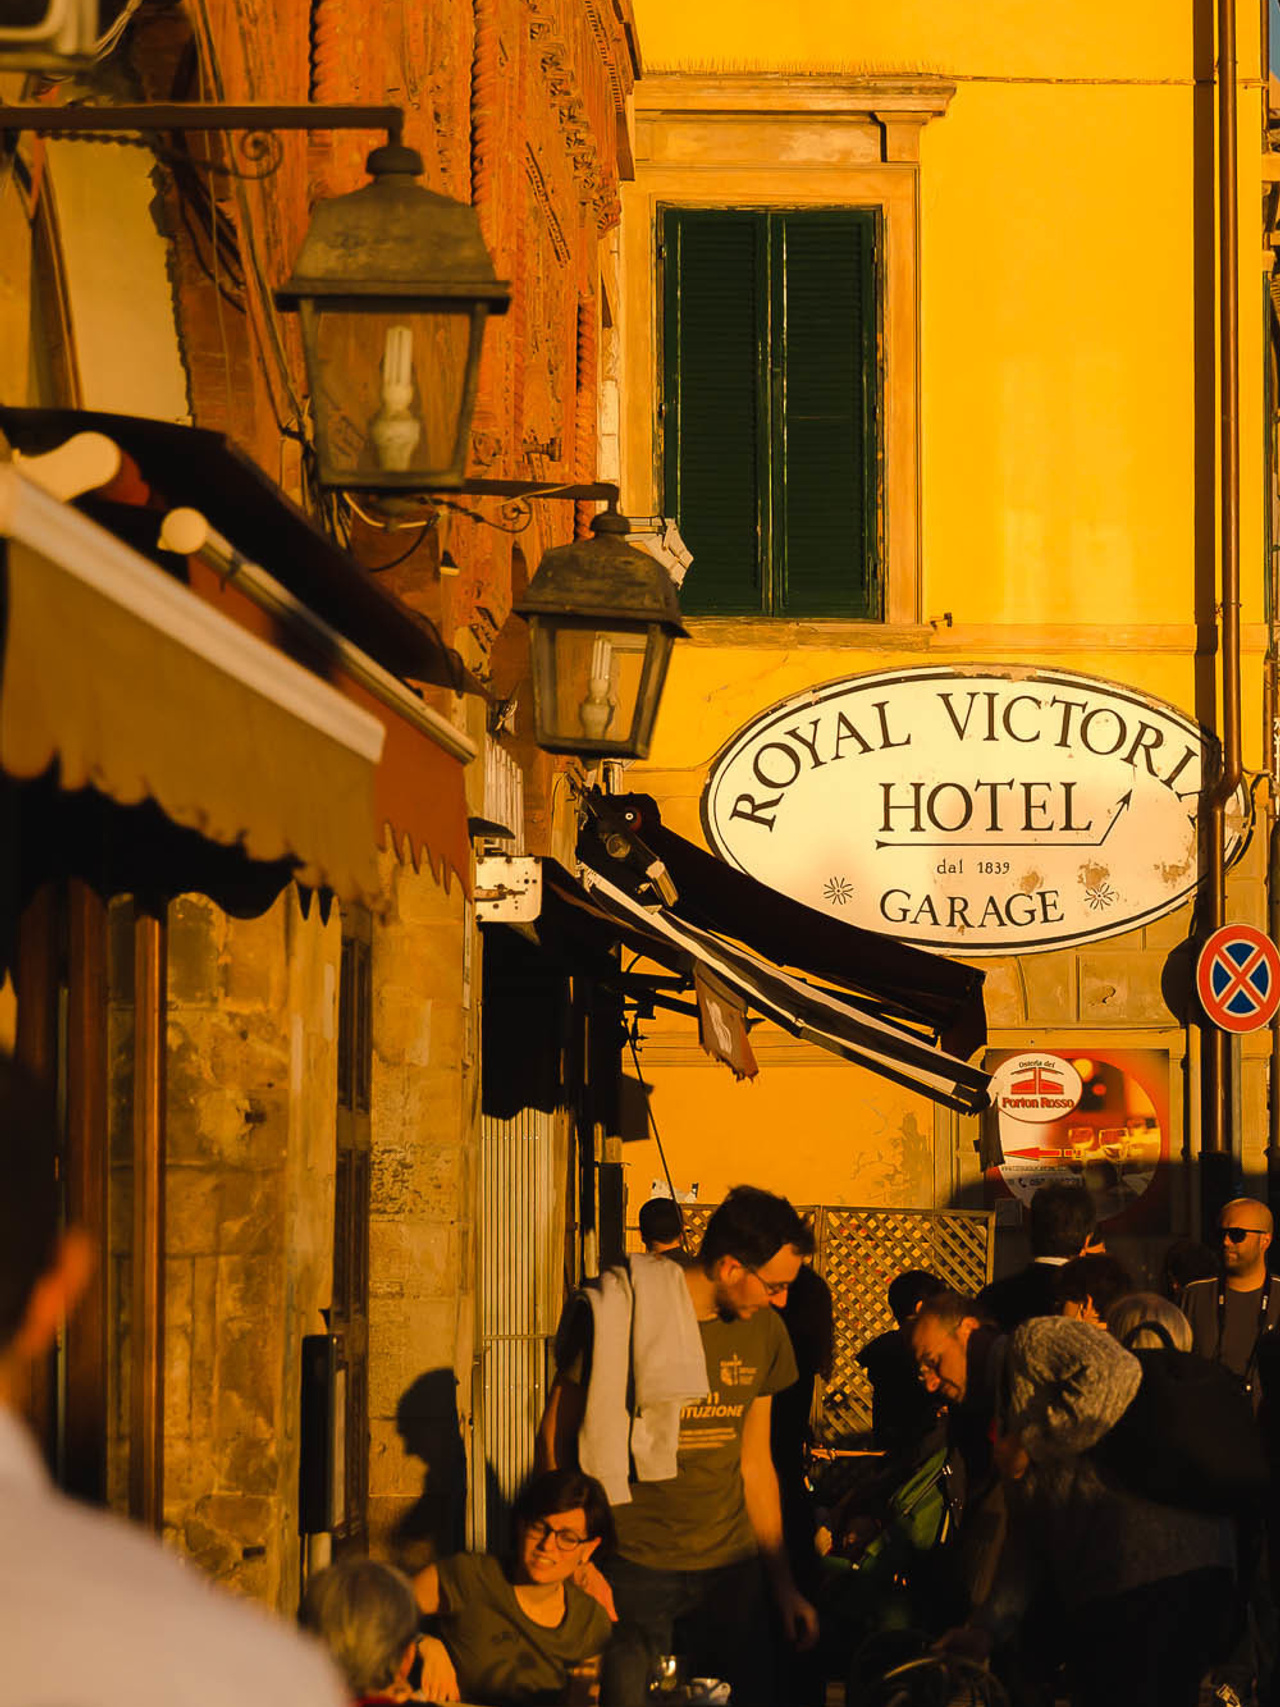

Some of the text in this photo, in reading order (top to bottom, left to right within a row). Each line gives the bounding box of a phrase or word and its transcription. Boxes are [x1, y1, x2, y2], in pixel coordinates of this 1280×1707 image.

[729, 691, 1205, 832] ROYAL VICTORI
[877, 777, 1093, 833] HOTEL
[936, 858, 1010, 875] dal 1839
[879, 888, 1065, 929] GARAGE
[1002, 1096, 1075, 1109] Porton Rosso
[679, 1404, 745, 1419] ITUZIONE
